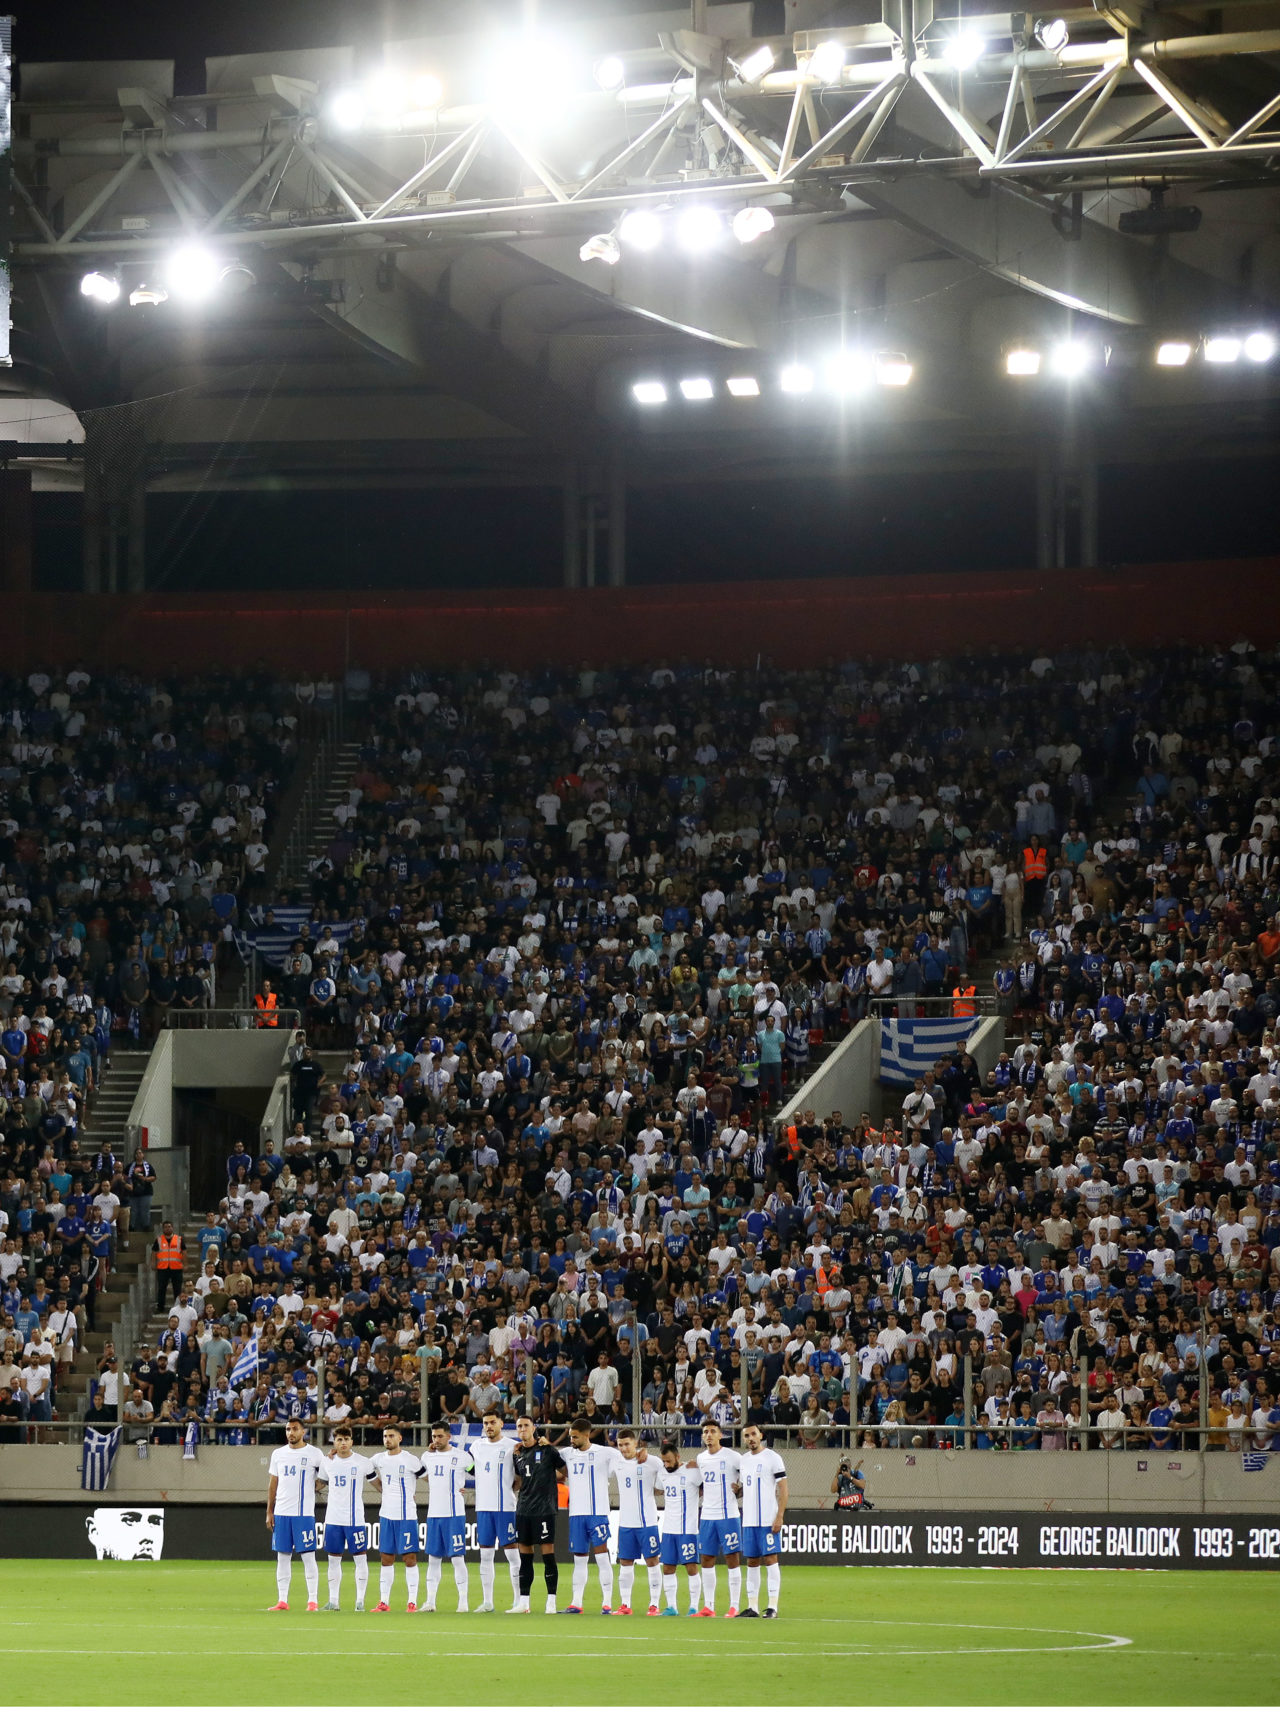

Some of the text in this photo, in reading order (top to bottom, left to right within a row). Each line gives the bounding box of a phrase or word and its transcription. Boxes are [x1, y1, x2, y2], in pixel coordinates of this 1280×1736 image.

[284, 1465, 296, 1476] 14
[434, 1466, 444, 1476] 11
[484, 1462, 491, 1472] 4
[524, 1464, 532, 1476] 1
[574, 1462, 584, 1474] 17
[334, 1476, 346, 1487] 15
[386, 1474, 392, 1485] 7
[625, 1477, 632, 1488] 8
[704, 1472, 716, 1482] 22
[746, 1475, 752, 1486] 6
[666, 1486, 677, 1497] 23
[840, 1494, 859, 1505] PHOTO
[508, 1523, 514, 1535] 4
[542, 1522, 548, 1534] 1
[595, 1525, 607, 1538] 17
[302, 1530, 315, 1542] 14
[353, 1531, 366, 1544] 15
[403, 1532, 410, 1545] 7
[452, 1534, 464, 1546] 11
[648, 1536, 658, 1548] 8
[724, 1532, 738, 1546] 22
[766, 1533, 774, 1546] 6
[781, 1525, 837, 1553] GEORGE
[842, 1525, 912, 1553] BALDOCK
[926, 1526, 963, 1554] 1993
[978, 1527, 1019, 1554] 2024
[1040, 1527, 1102, 1555] GEORGE
[1106, 1527, 1180, 1556] BALDOCK
[1193, 1528, 1233, 1557] 1993
[1249, 1528, 1280, 1557] 202
[682, 1543, 696, 1556] 23
